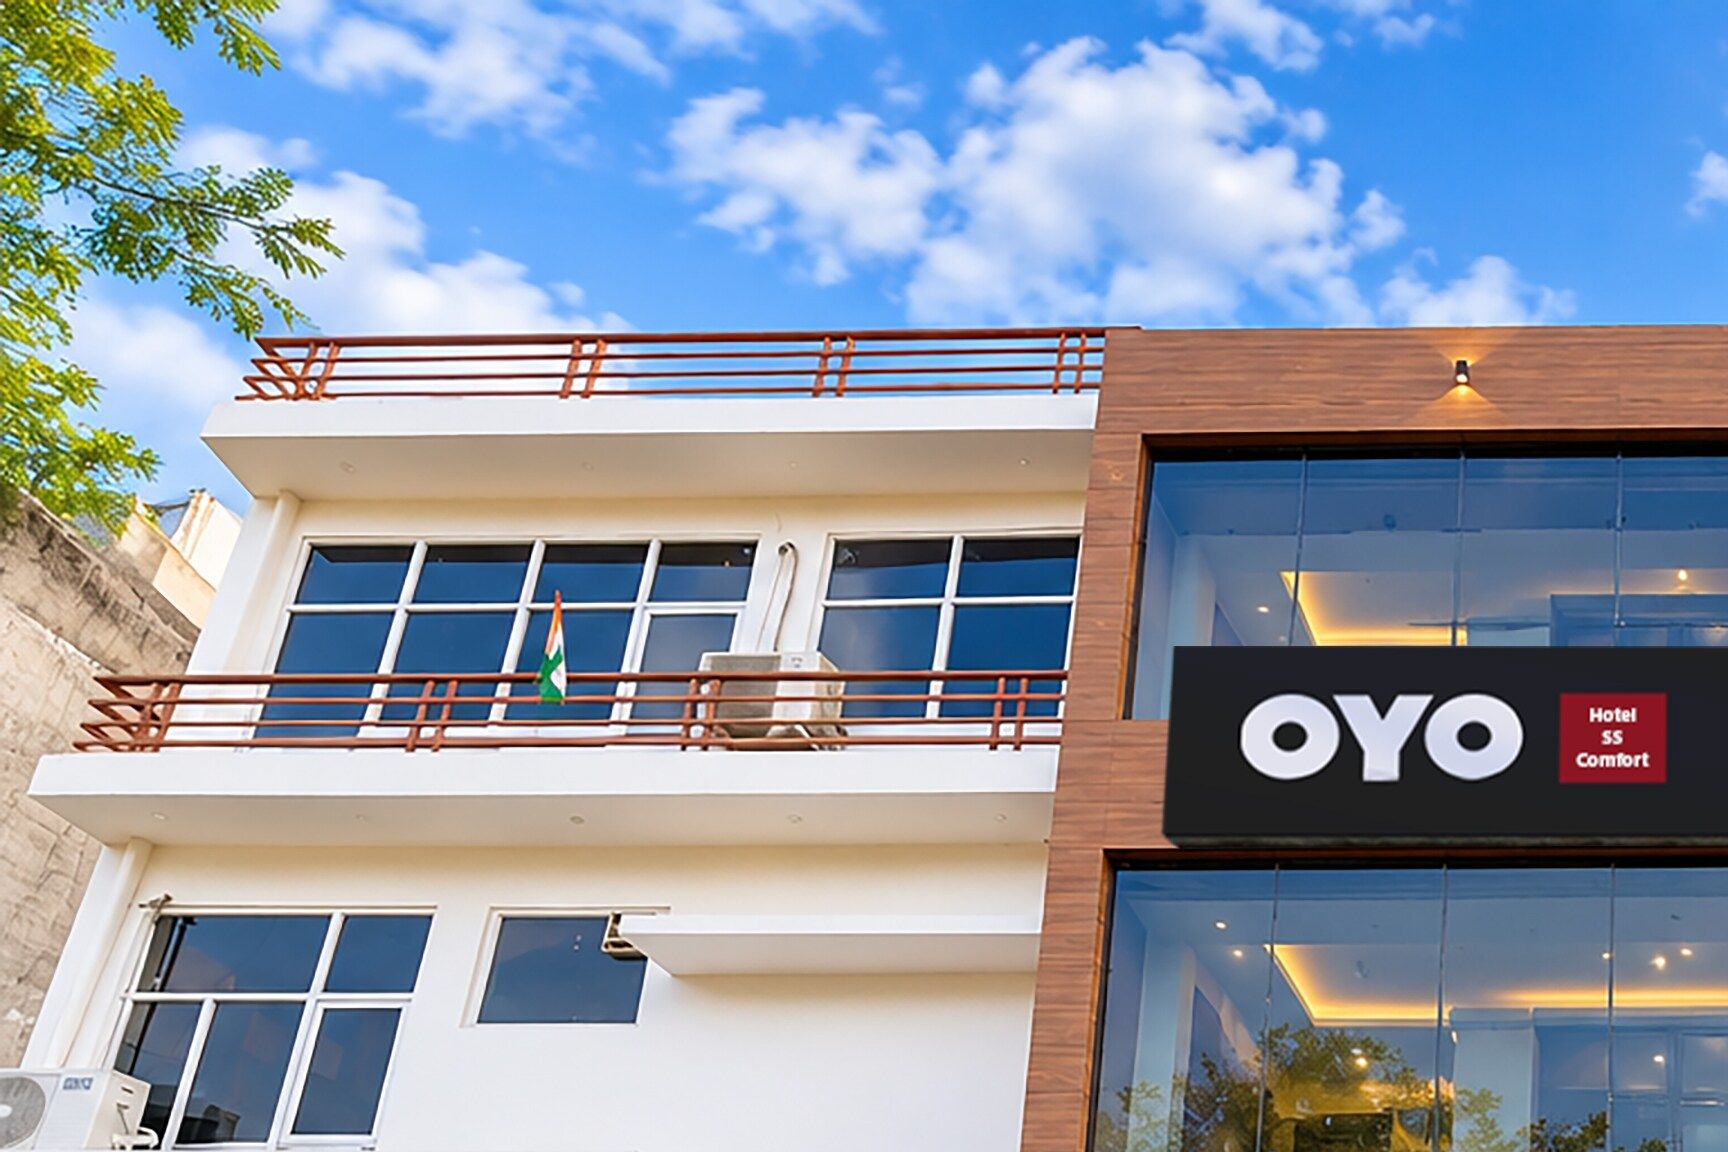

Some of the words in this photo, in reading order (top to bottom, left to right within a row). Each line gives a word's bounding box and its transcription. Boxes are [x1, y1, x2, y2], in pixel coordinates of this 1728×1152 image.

[1589, 707, 1637, 723] Hotel
[1241, 694, 1523, 781] OYO
[1602, 729, 1623, 745] SS
[1576, 752, 1649, 768] Comfort
